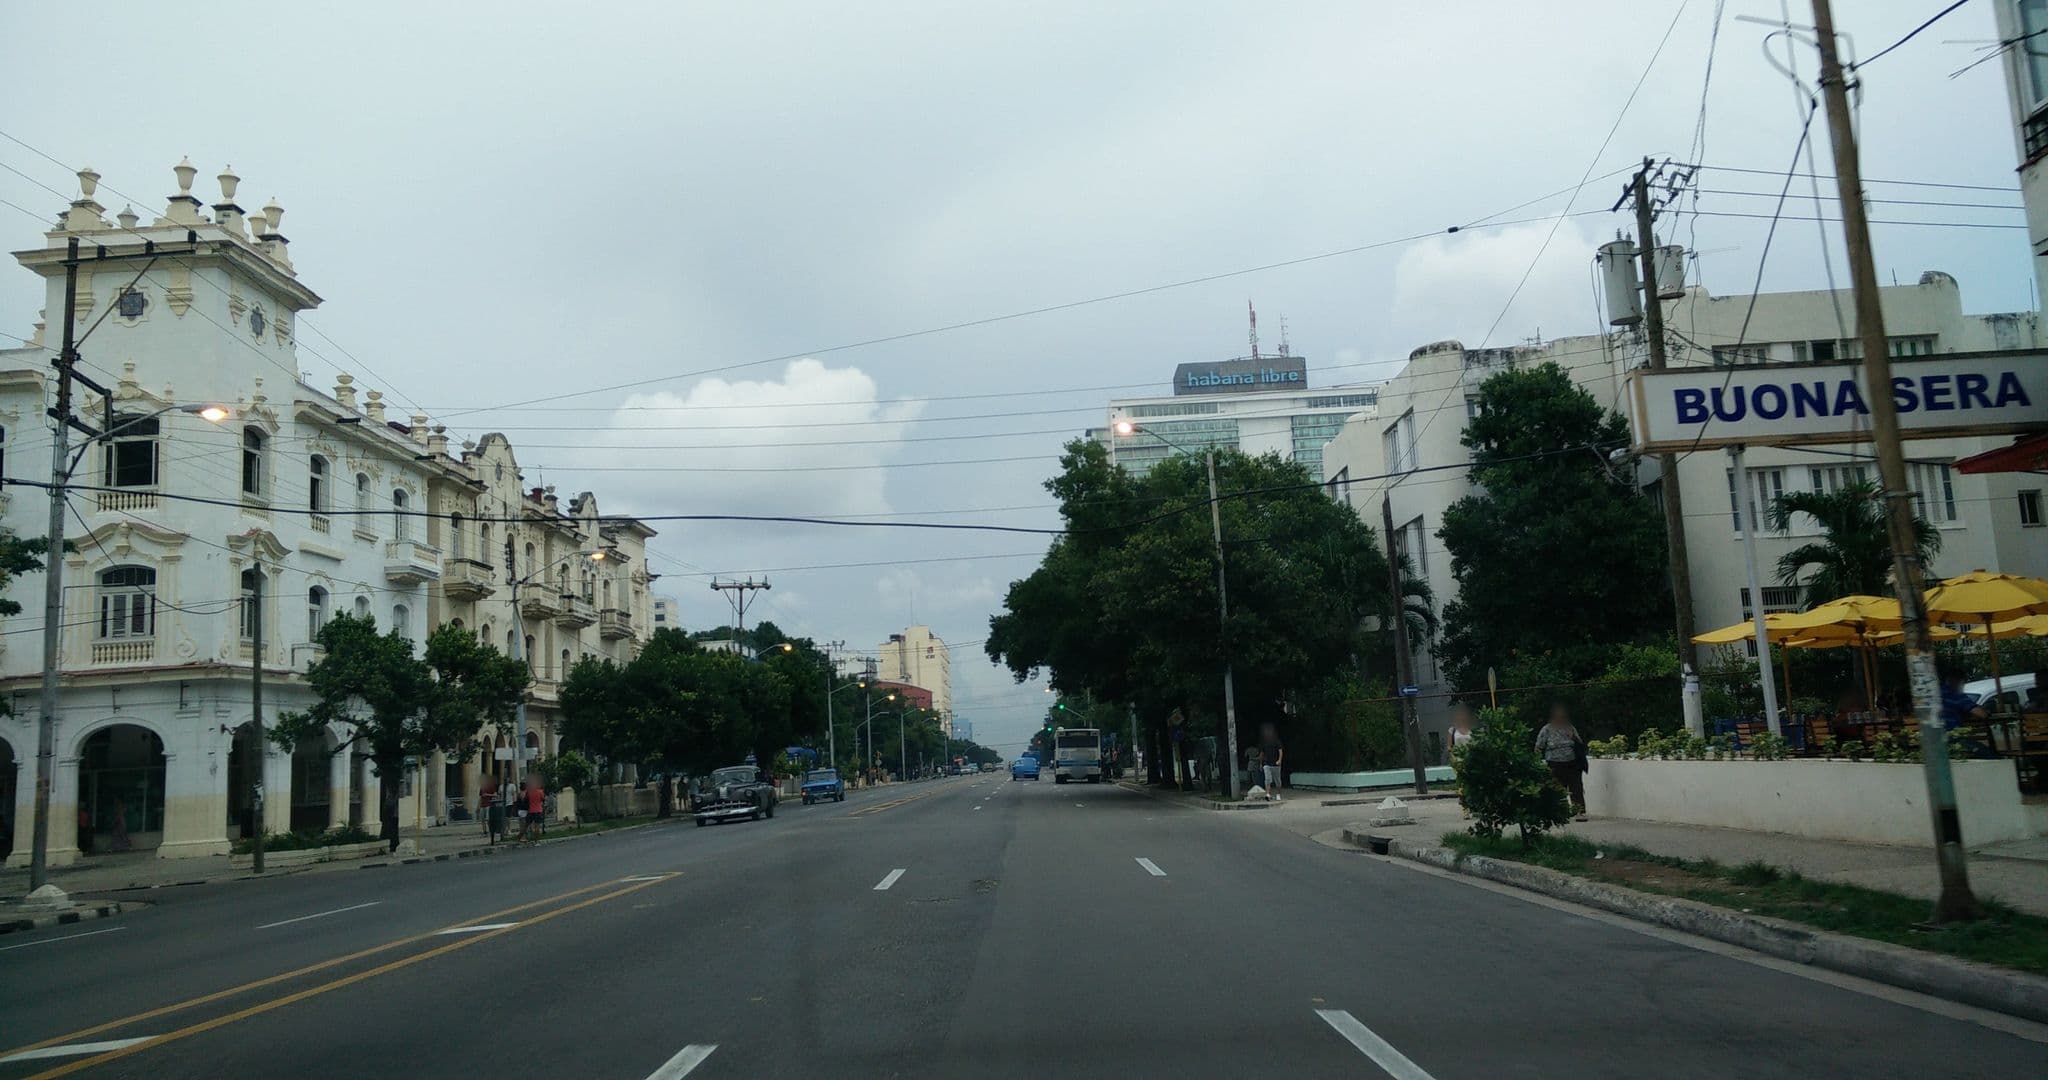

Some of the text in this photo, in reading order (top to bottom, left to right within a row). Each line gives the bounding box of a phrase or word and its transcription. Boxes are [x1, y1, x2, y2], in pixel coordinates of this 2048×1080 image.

[1188, 368, 1298, 387] habana libre
[1673, 371, 2031, 425] BUONA SERA
